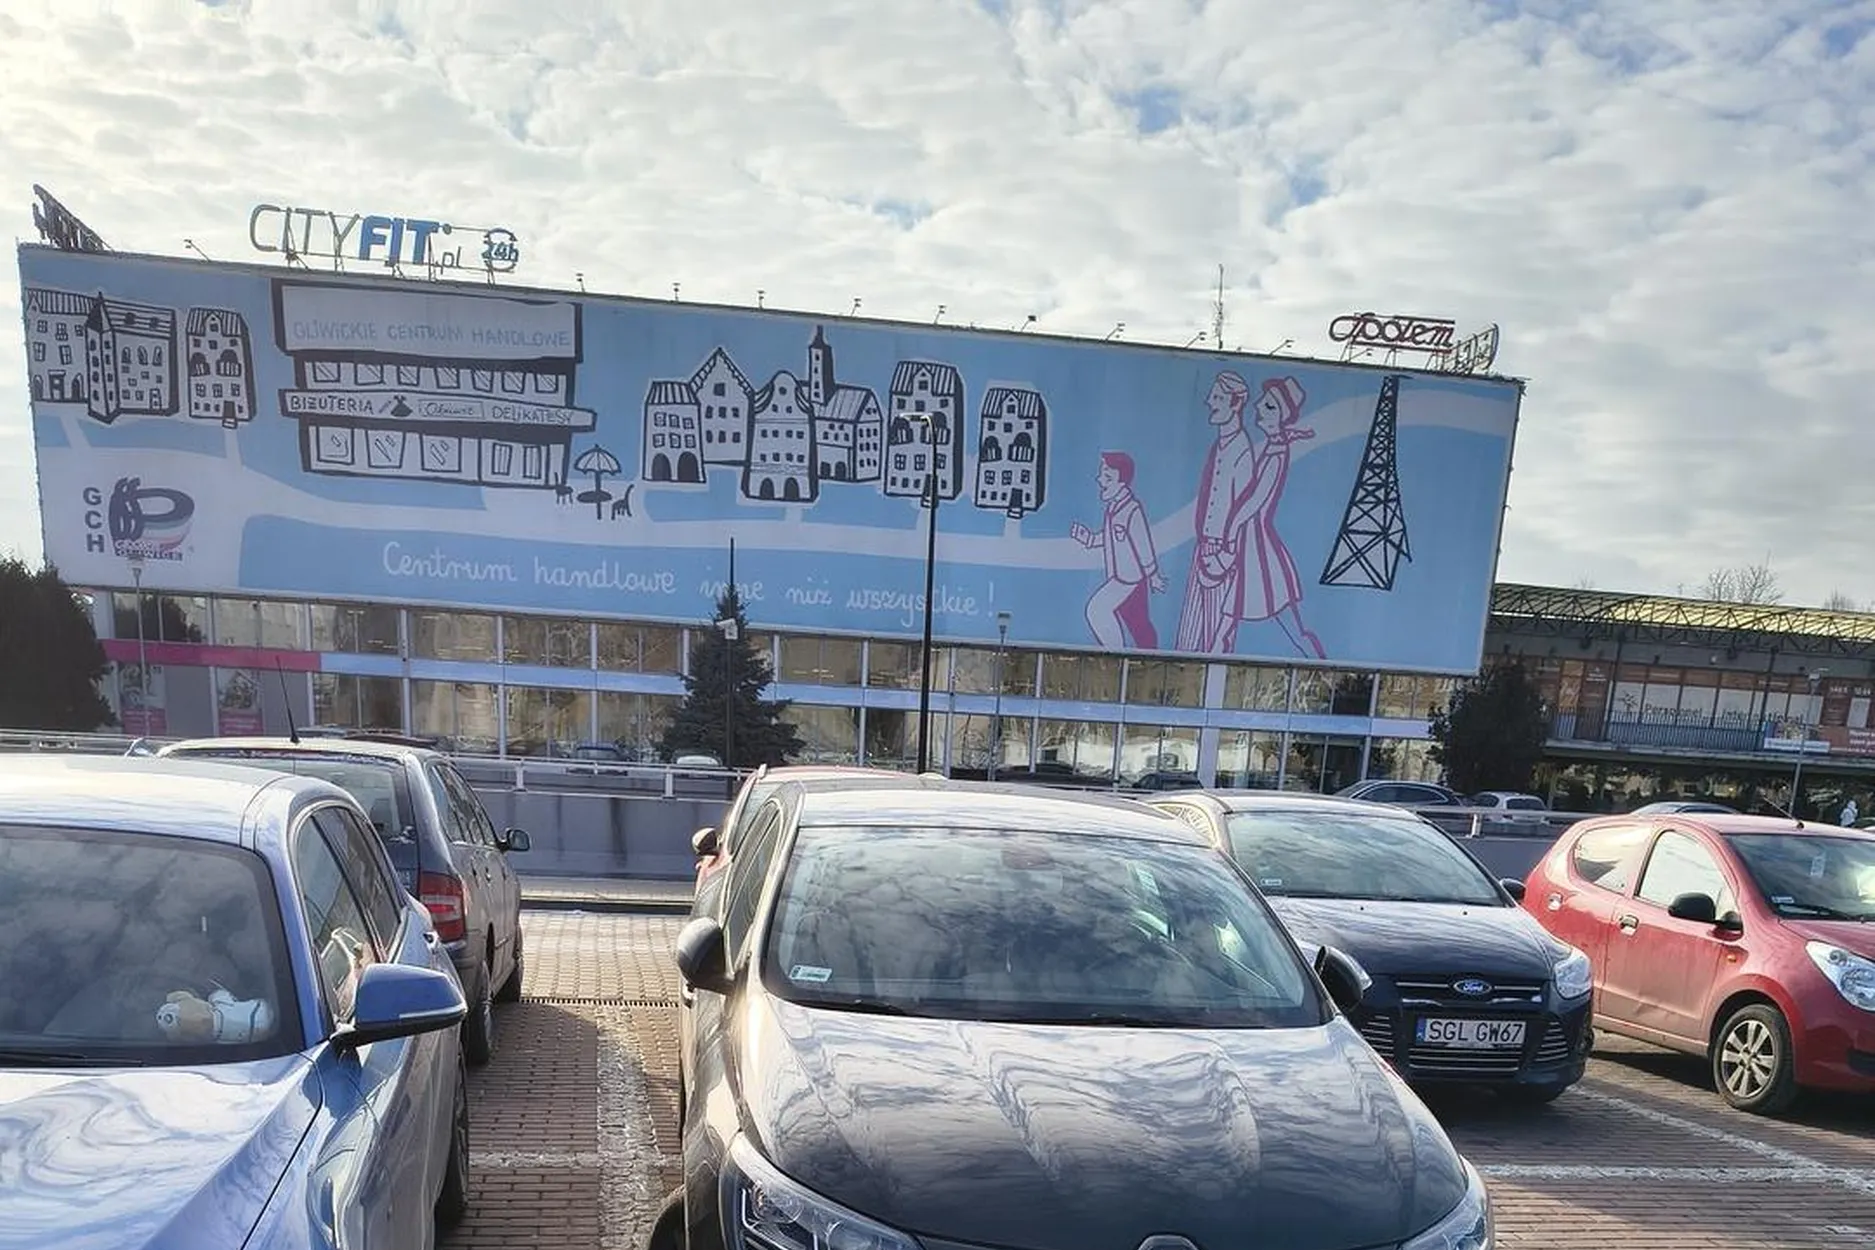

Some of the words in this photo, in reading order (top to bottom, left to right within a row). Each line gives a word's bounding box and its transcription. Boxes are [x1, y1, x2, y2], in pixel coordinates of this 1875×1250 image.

[491, 405, 574, 424] DELIKATESY
[383, 541, 518, 582] Centrum
[533, 555, 677, 594] handlowe
[786, 577, 832, 605] niż
[1429, 1021, 1468, 1040] SGL
[1476, 1022, 1523, 1043] GW67
